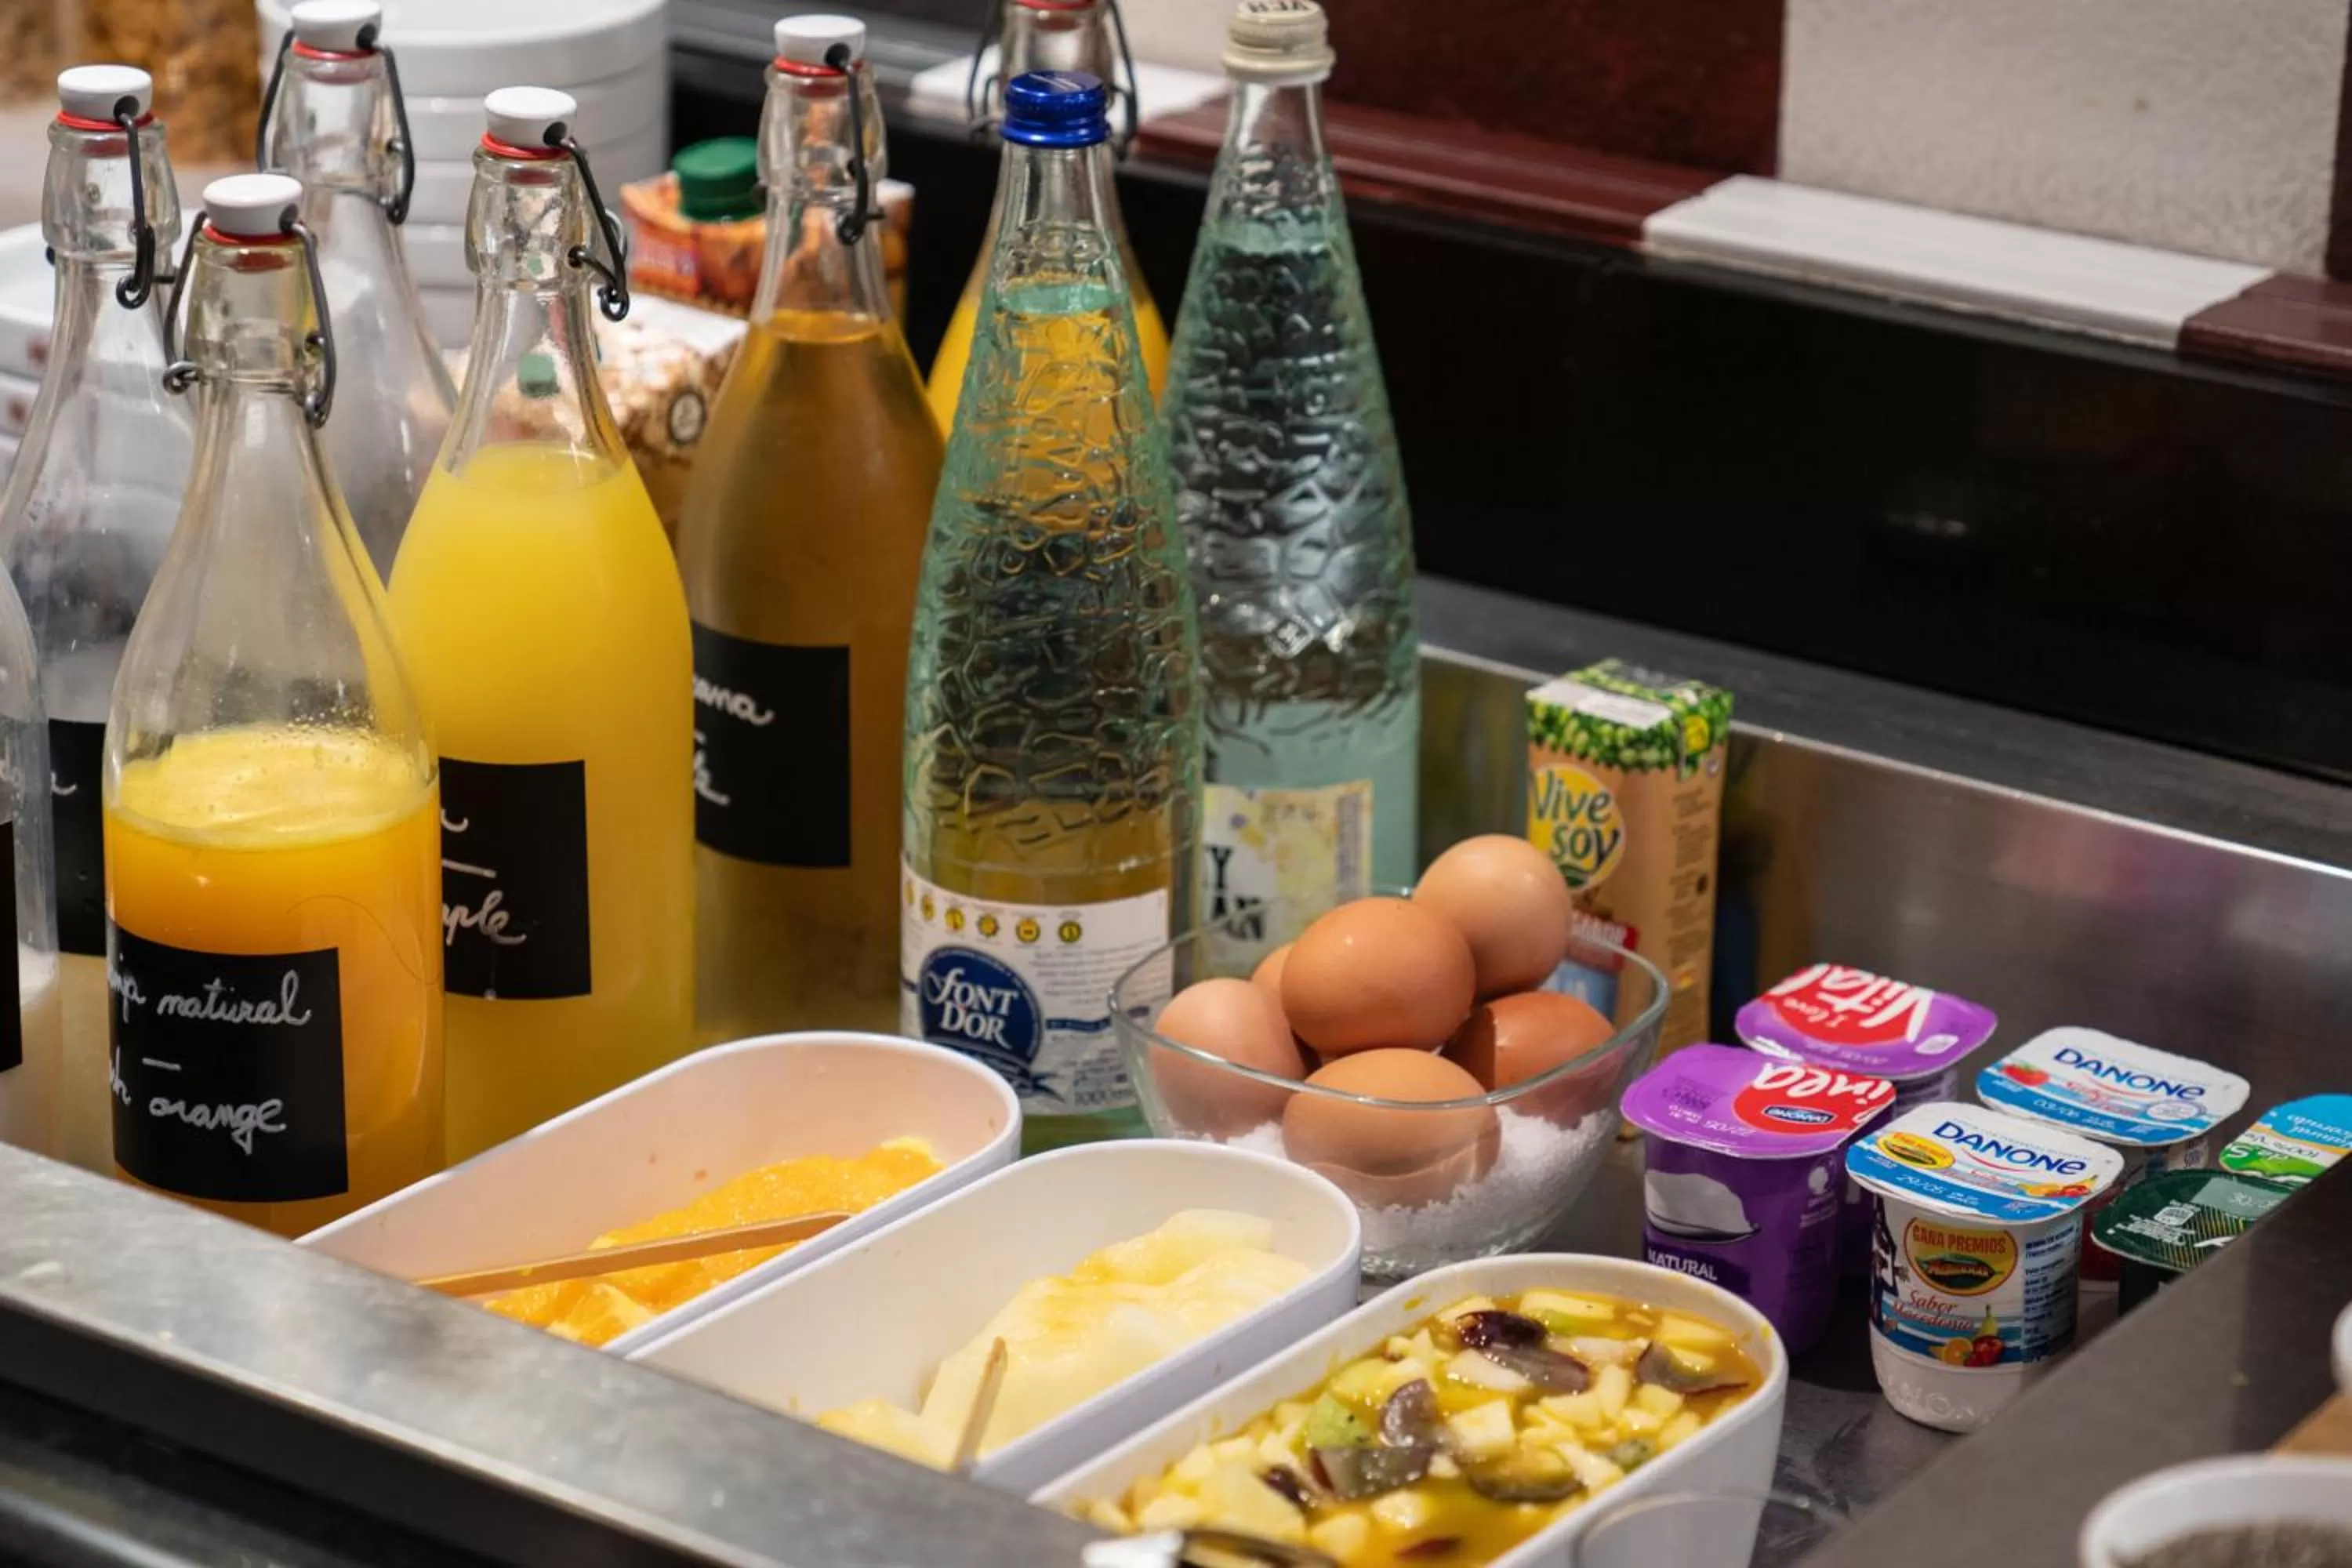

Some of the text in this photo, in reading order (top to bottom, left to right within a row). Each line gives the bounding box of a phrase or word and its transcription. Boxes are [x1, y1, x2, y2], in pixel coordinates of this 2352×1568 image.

[1533, 767, 1611, 824] Vive
[1552, 825, 1620, 872] soy
[149, 1098, 287, 1156] orange
[1947, 1232, 2007, 1254] PREMIOS
[1908, 1289, 1960, 1316] Sabor
